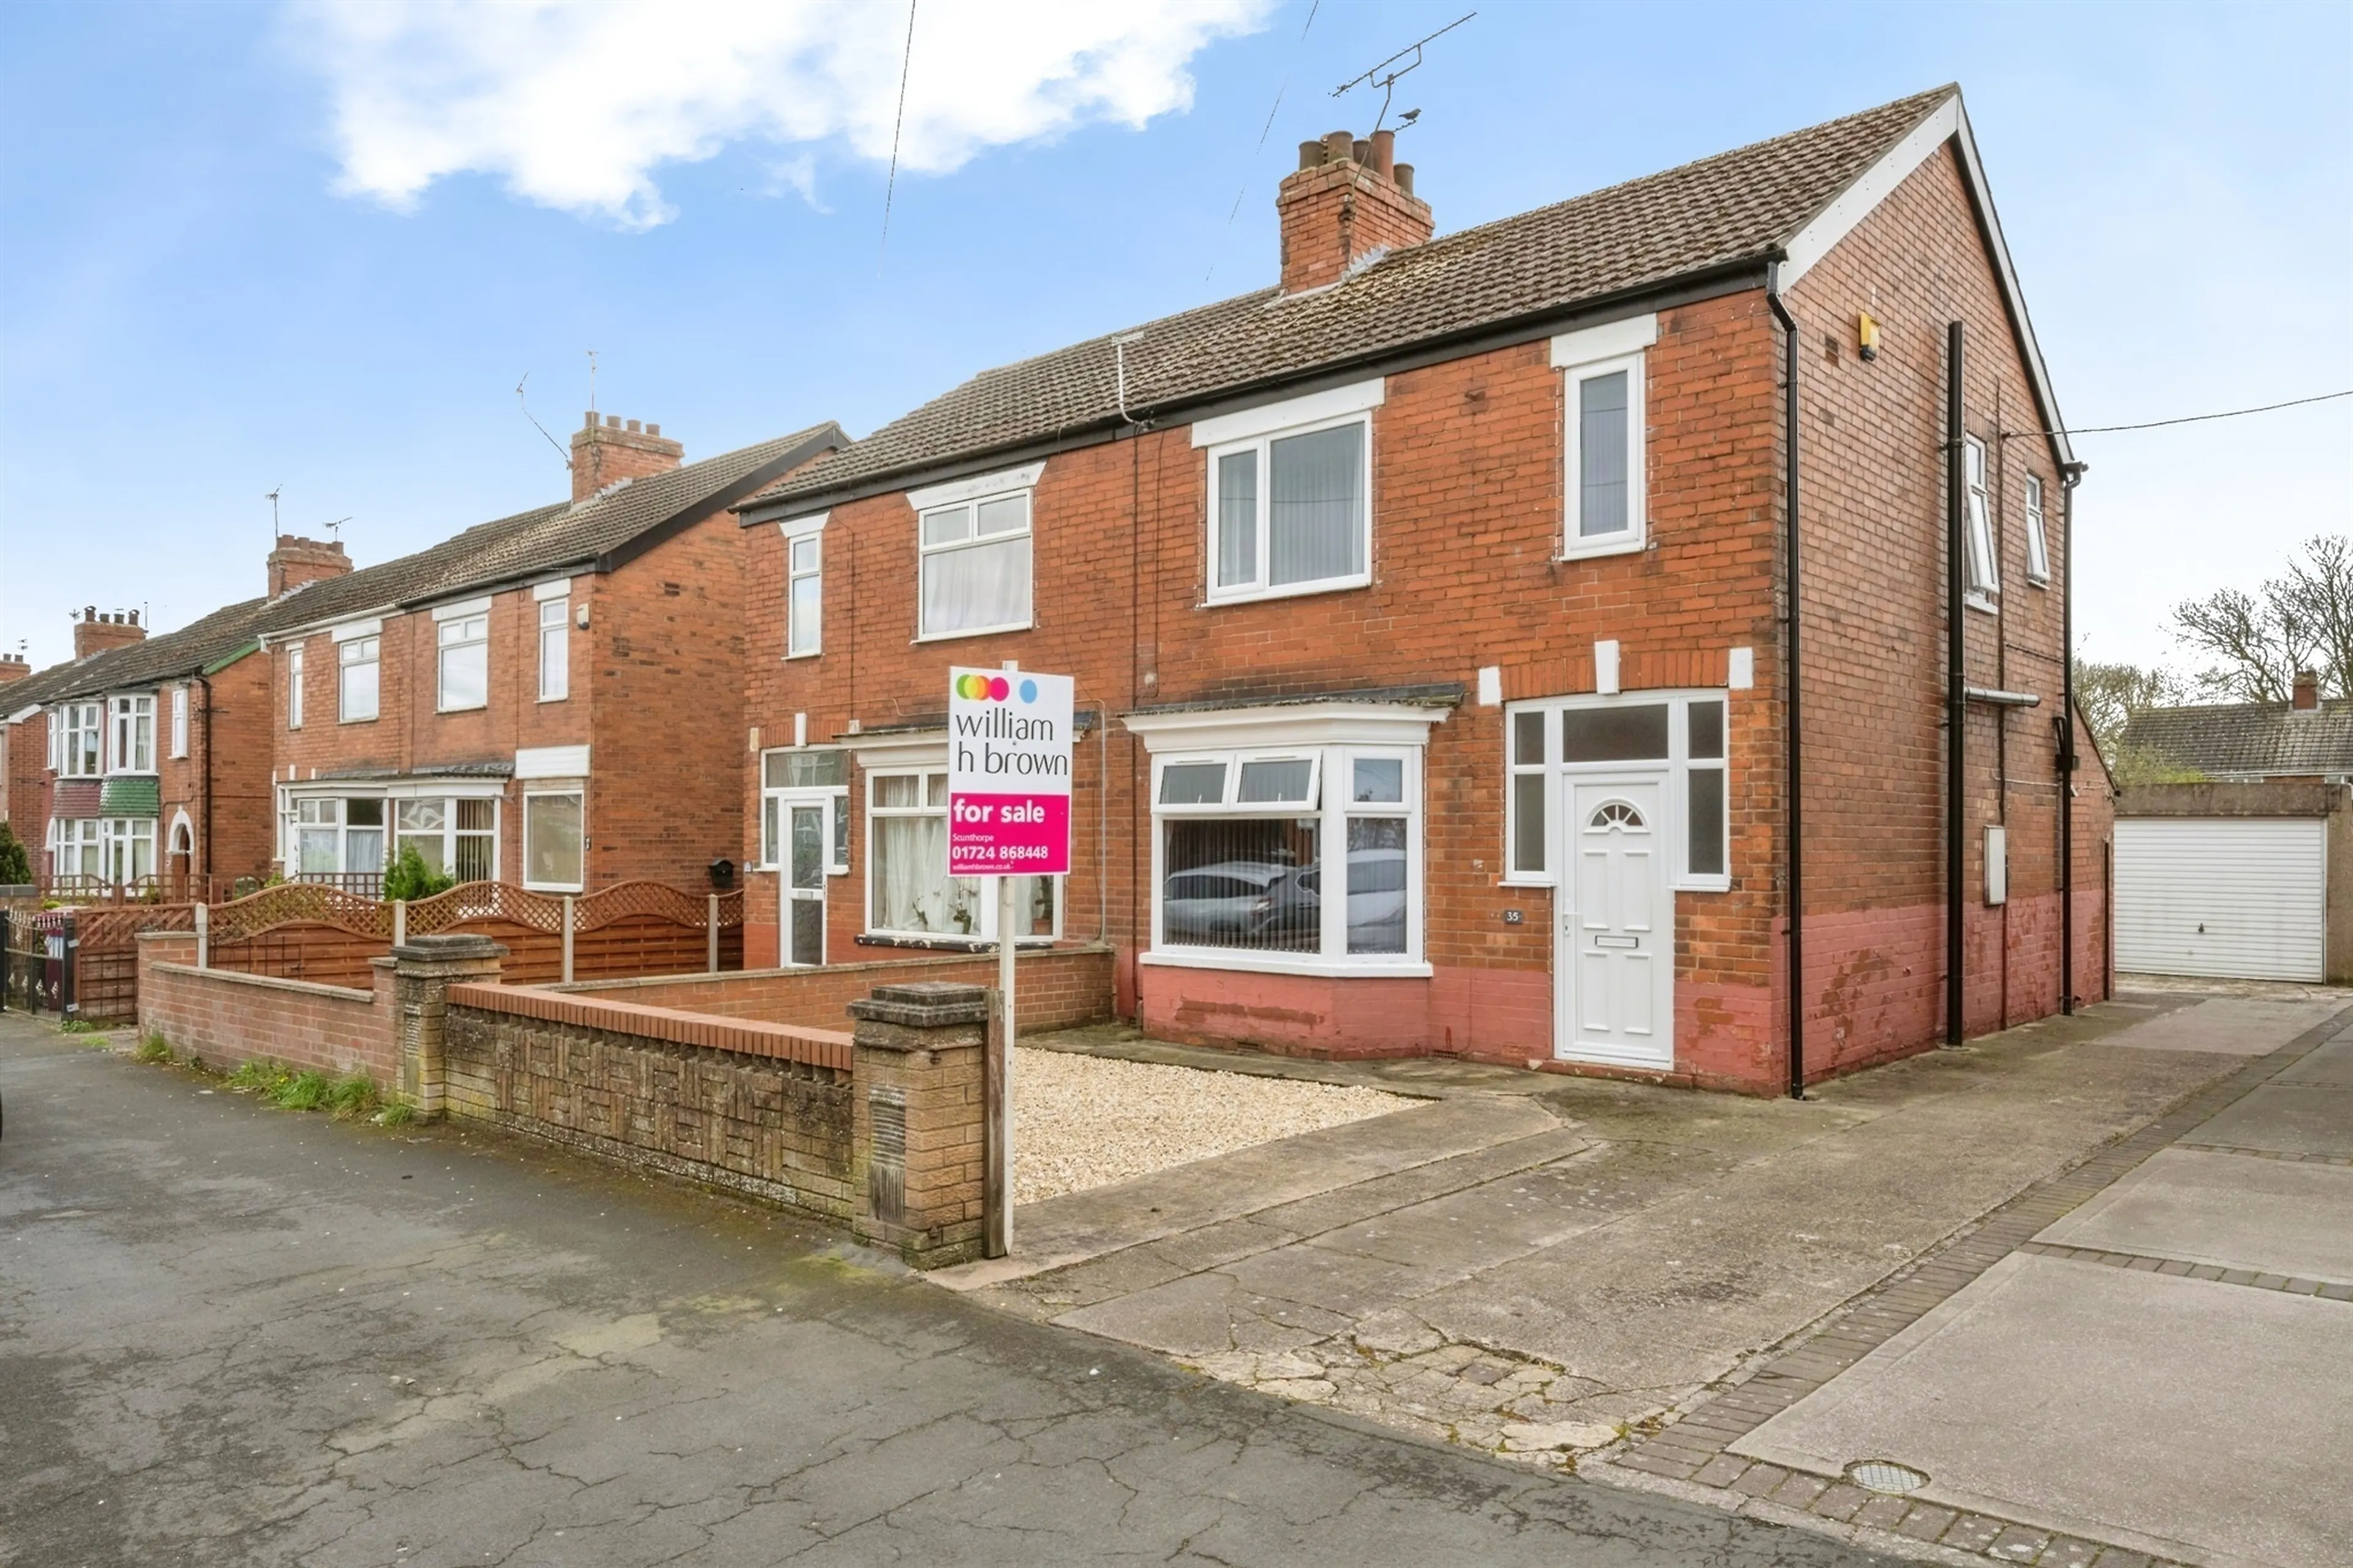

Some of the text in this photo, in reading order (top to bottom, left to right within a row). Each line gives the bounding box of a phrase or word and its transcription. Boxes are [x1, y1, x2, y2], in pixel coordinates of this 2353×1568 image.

[956, 707, 1053, 741] william
[958, 741, 1067, 775] h brown
[953, 798, 1045, 824] for sale
[952, 833, 994, 843] Scunthorpe
[952, 846, 1048, 860] 01724 868448
[1507, 912, 1519, 921] 35
